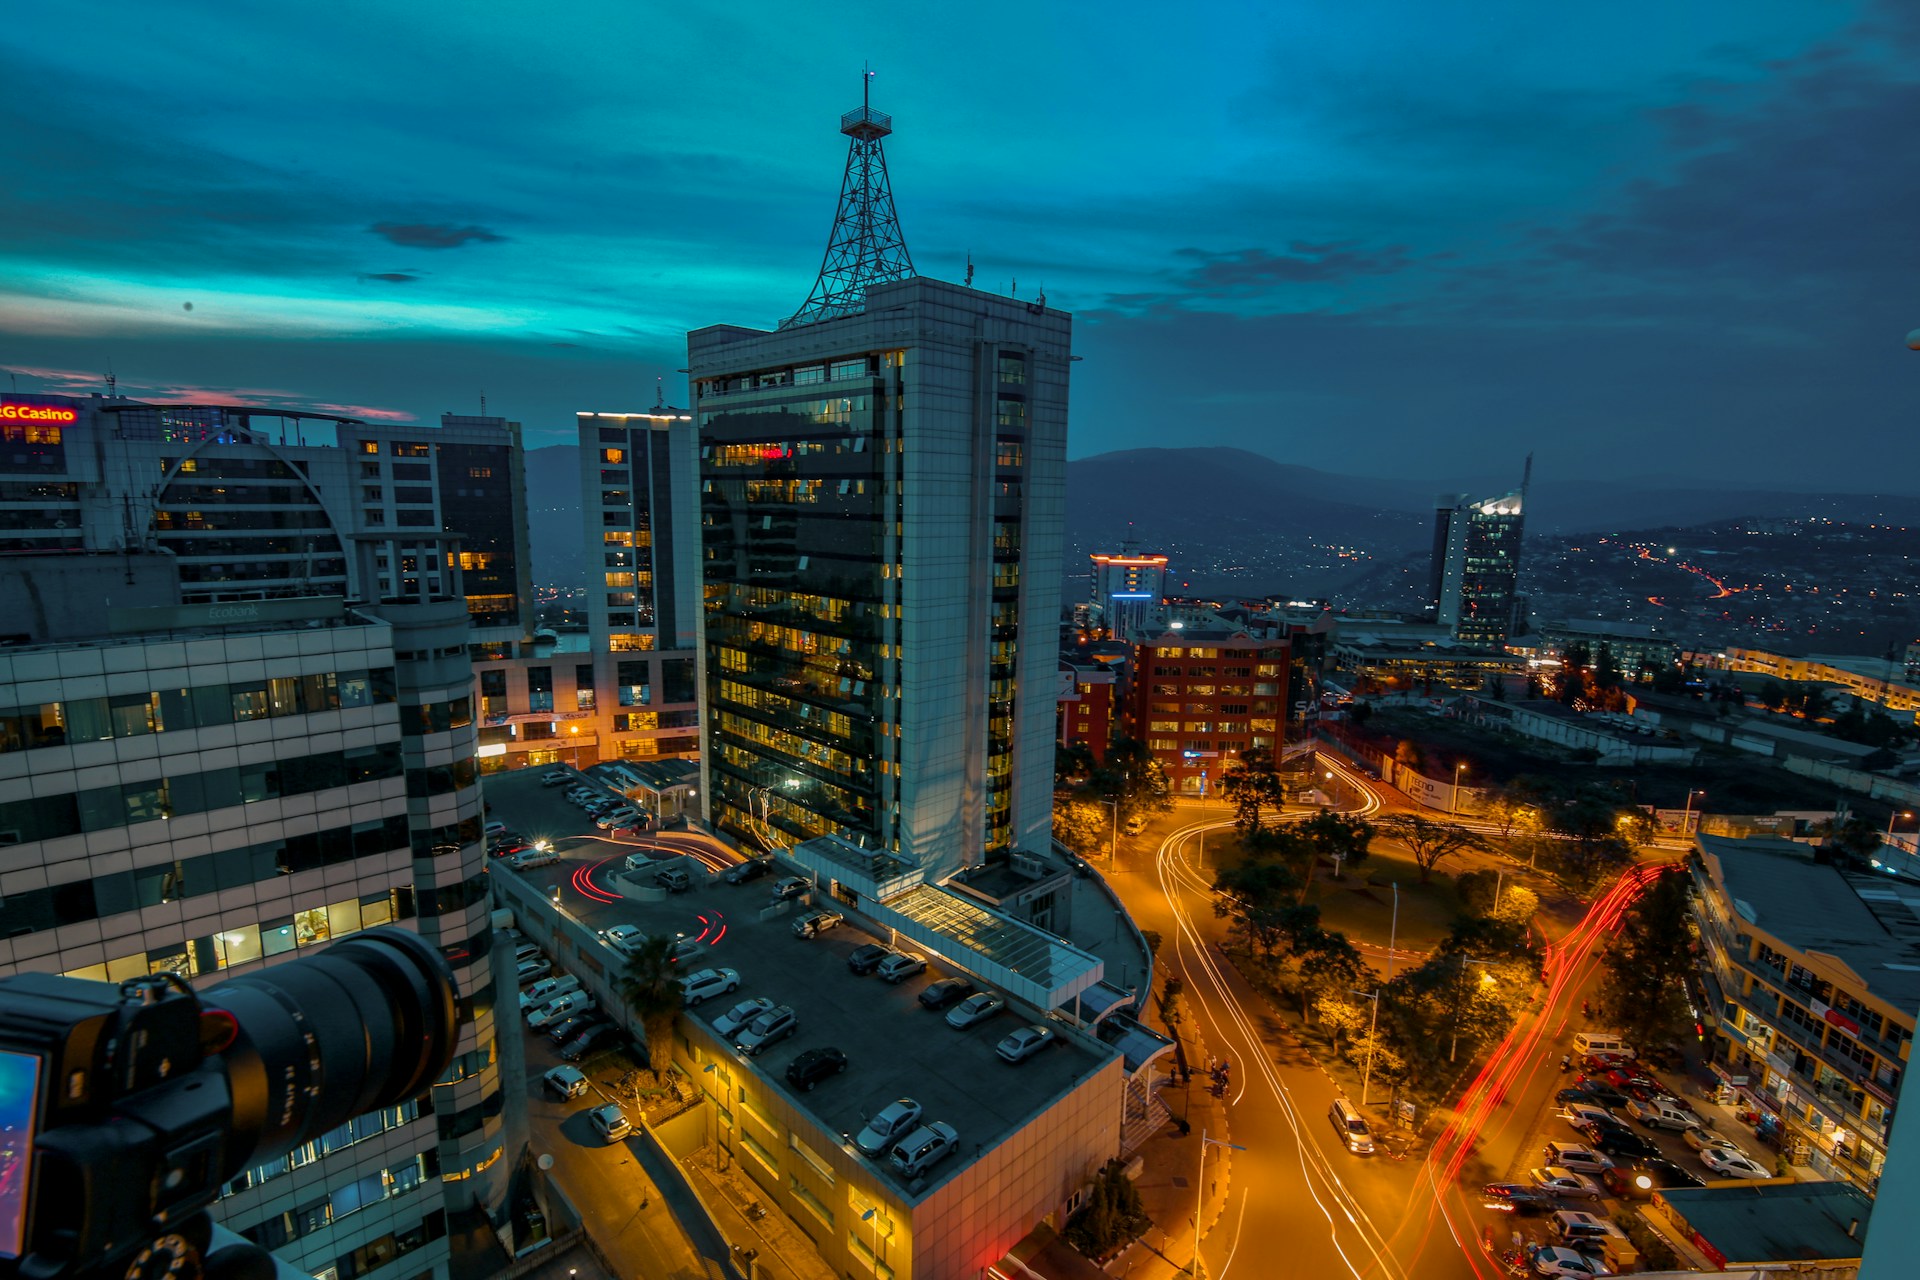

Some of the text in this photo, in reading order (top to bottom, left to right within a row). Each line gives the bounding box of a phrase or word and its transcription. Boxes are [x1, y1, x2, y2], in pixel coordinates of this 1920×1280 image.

[0, 406, 74, 421] G Casino
[209, 603, 258, 618] Ecobank
